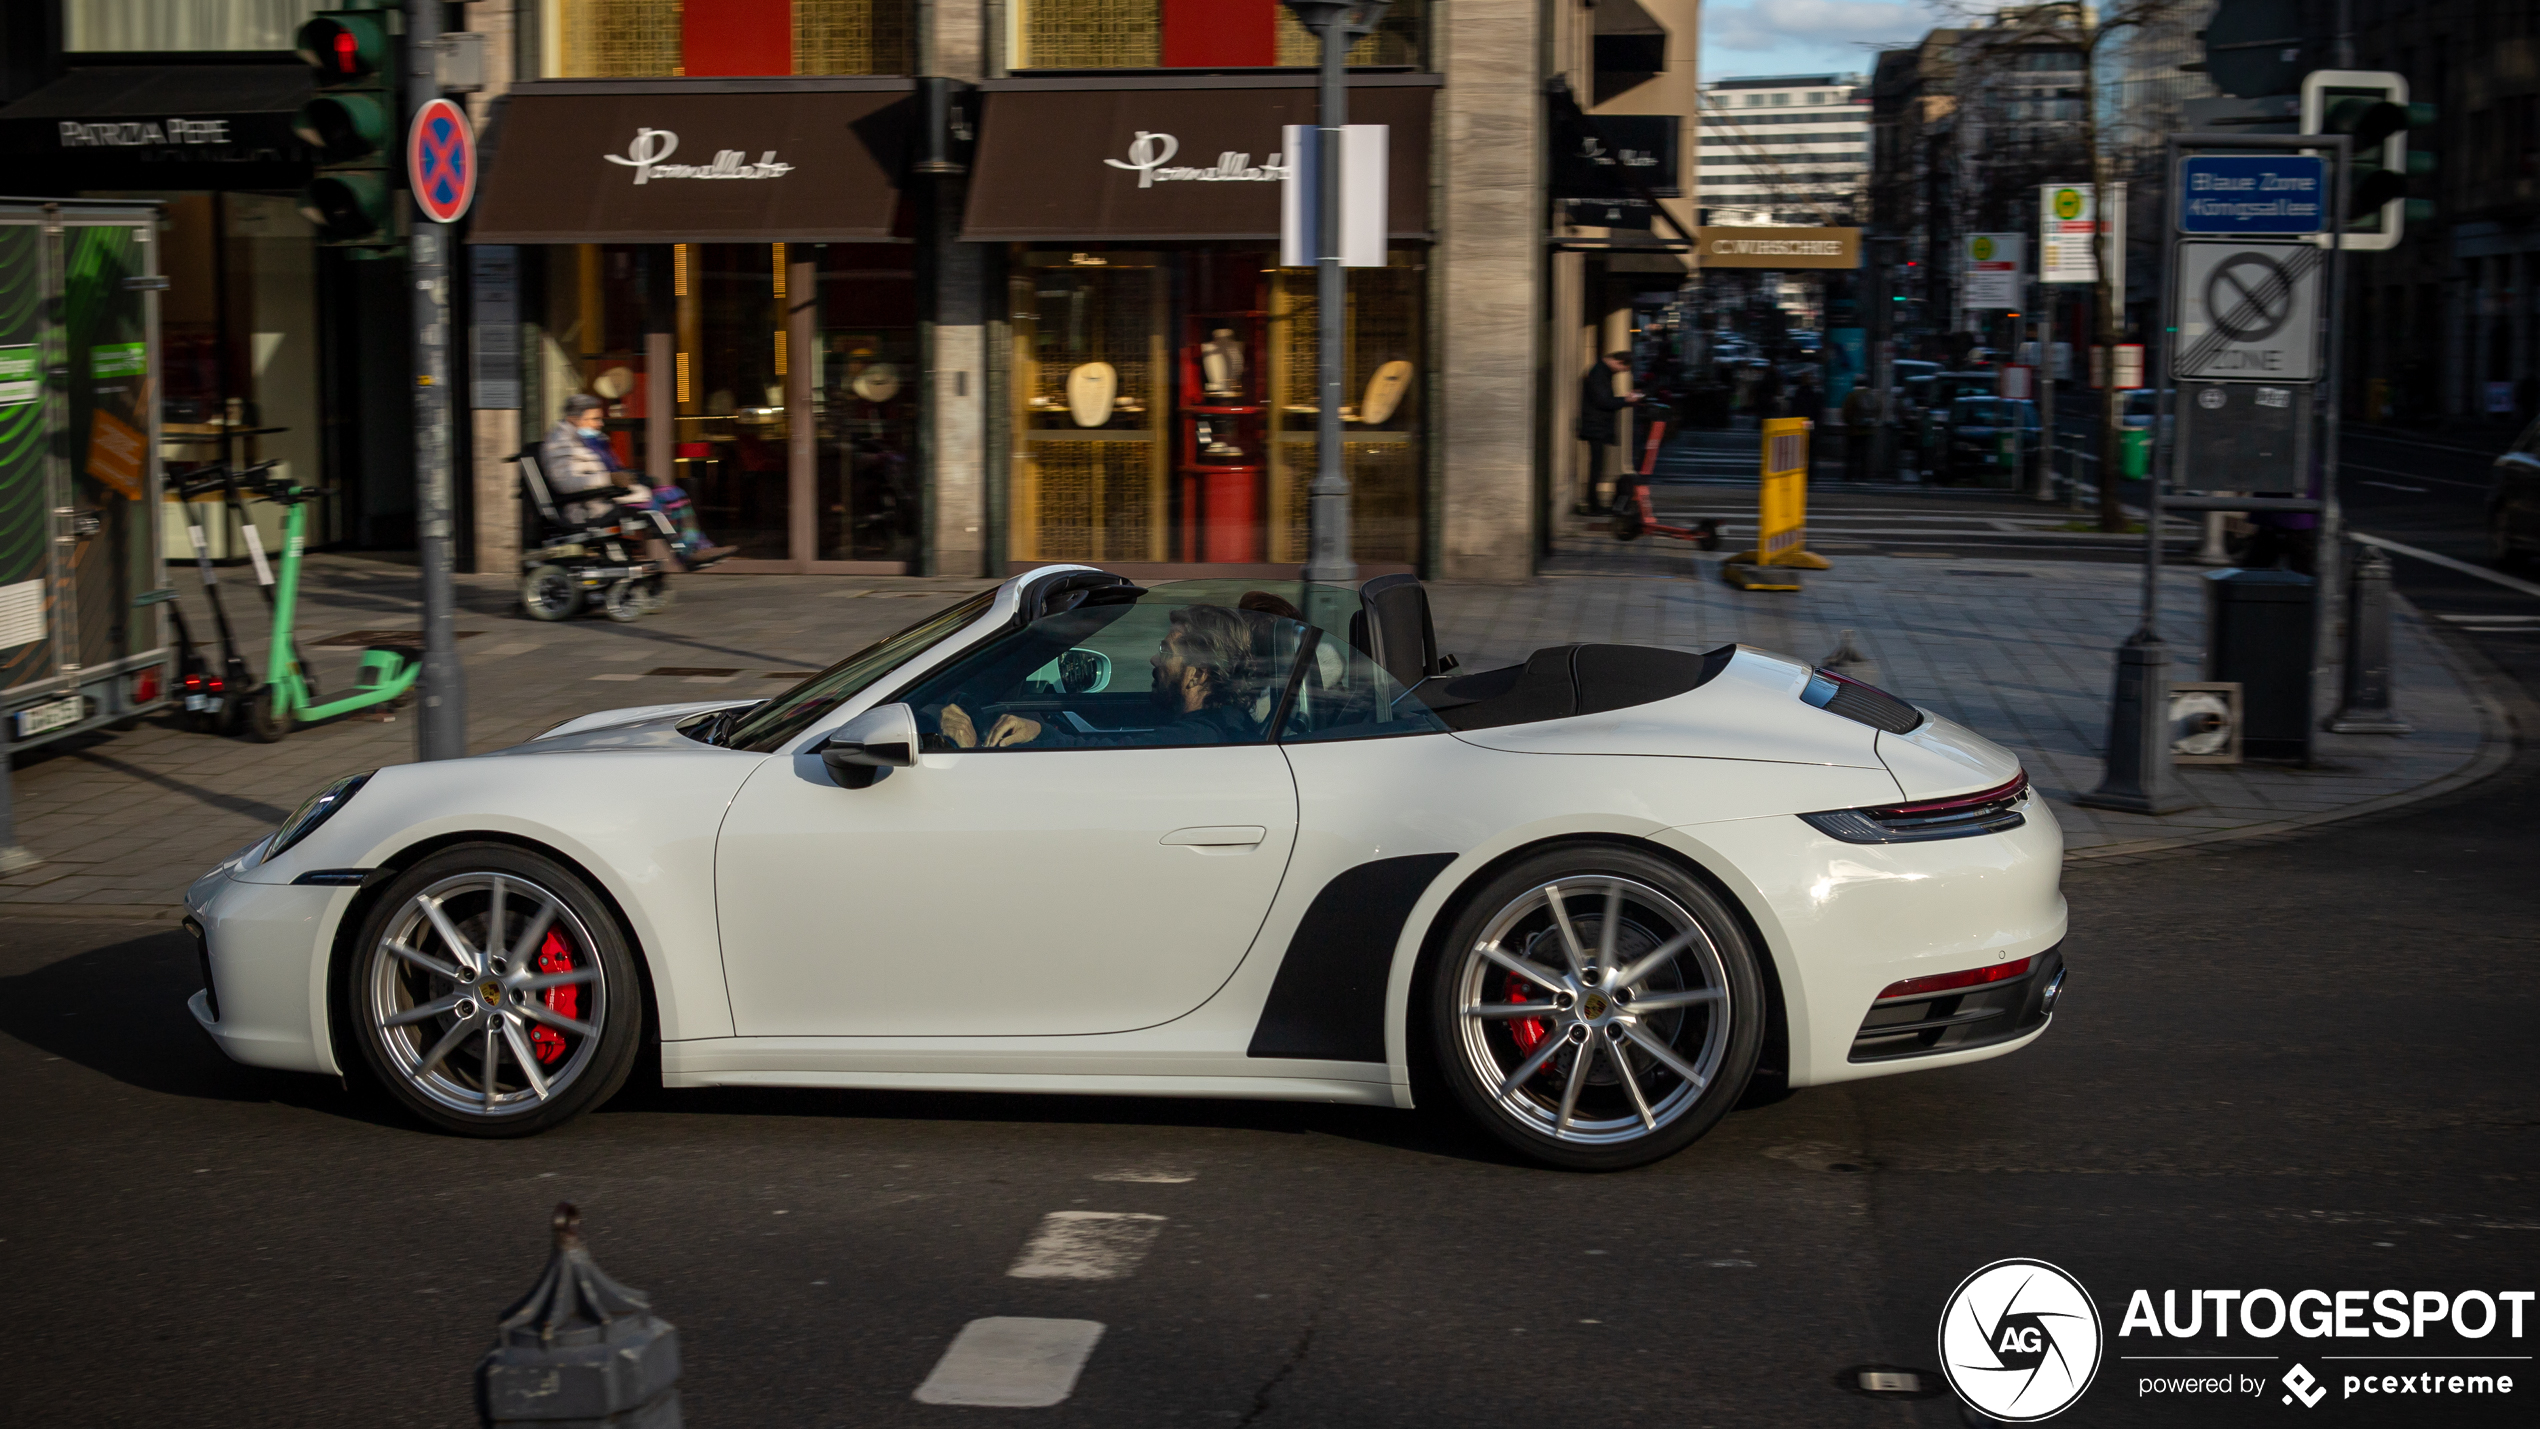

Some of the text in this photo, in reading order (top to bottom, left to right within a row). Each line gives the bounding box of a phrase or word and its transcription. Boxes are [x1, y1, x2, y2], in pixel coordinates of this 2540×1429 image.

[603, 127, 796, 185] Pomellato
[2191, 173, 2317, 190] Blaue Zone
[2211, 349, 2283, 371] ZONE
